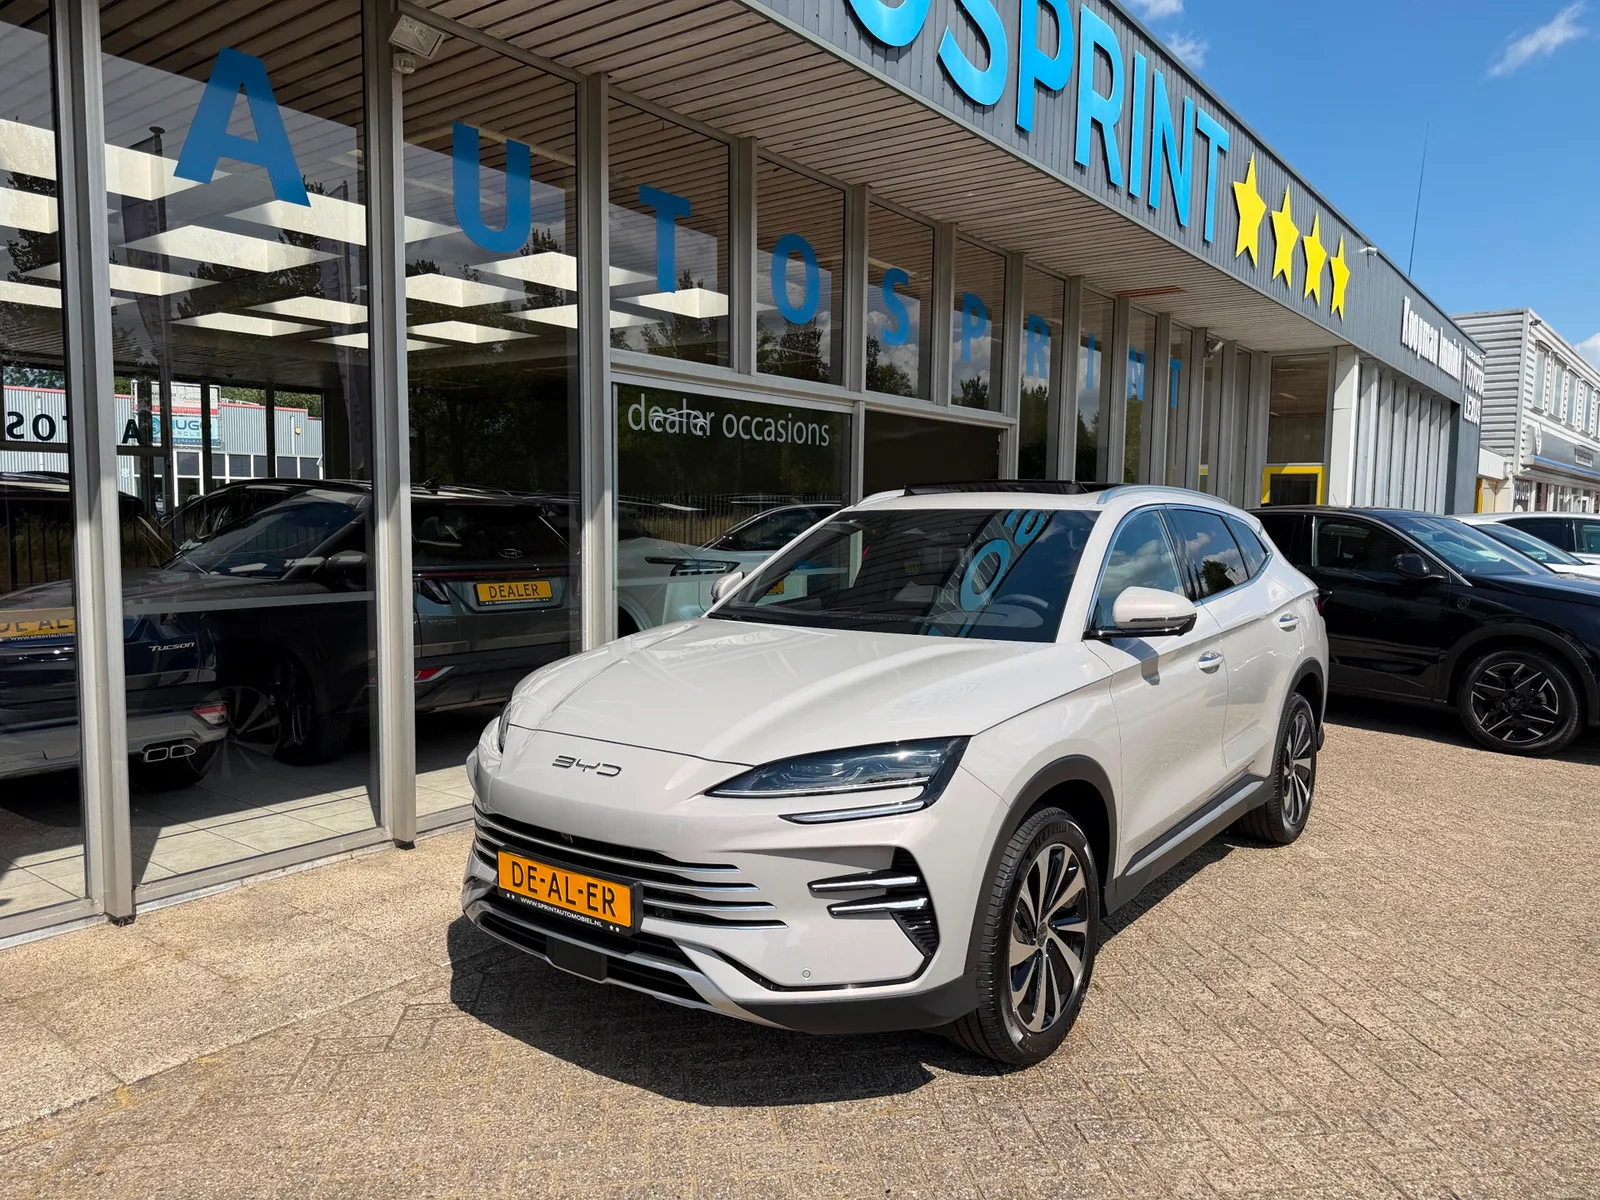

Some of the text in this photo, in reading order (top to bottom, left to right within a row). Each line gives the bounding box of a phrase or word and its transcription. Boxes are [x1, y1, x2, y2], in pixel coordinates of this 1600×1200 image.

[850, 0, 1229, 243] SPRINT
[628, 393, 830, 447] dealer occasions
[488, 583, 540, 599] DEALER
[552, 755, 622, 778] BYD
[511, 860, 617, 918] DE-AL-ER
[520, 896, 603, 928] WWW.SPRINTAUTOMOBIEL.NL
